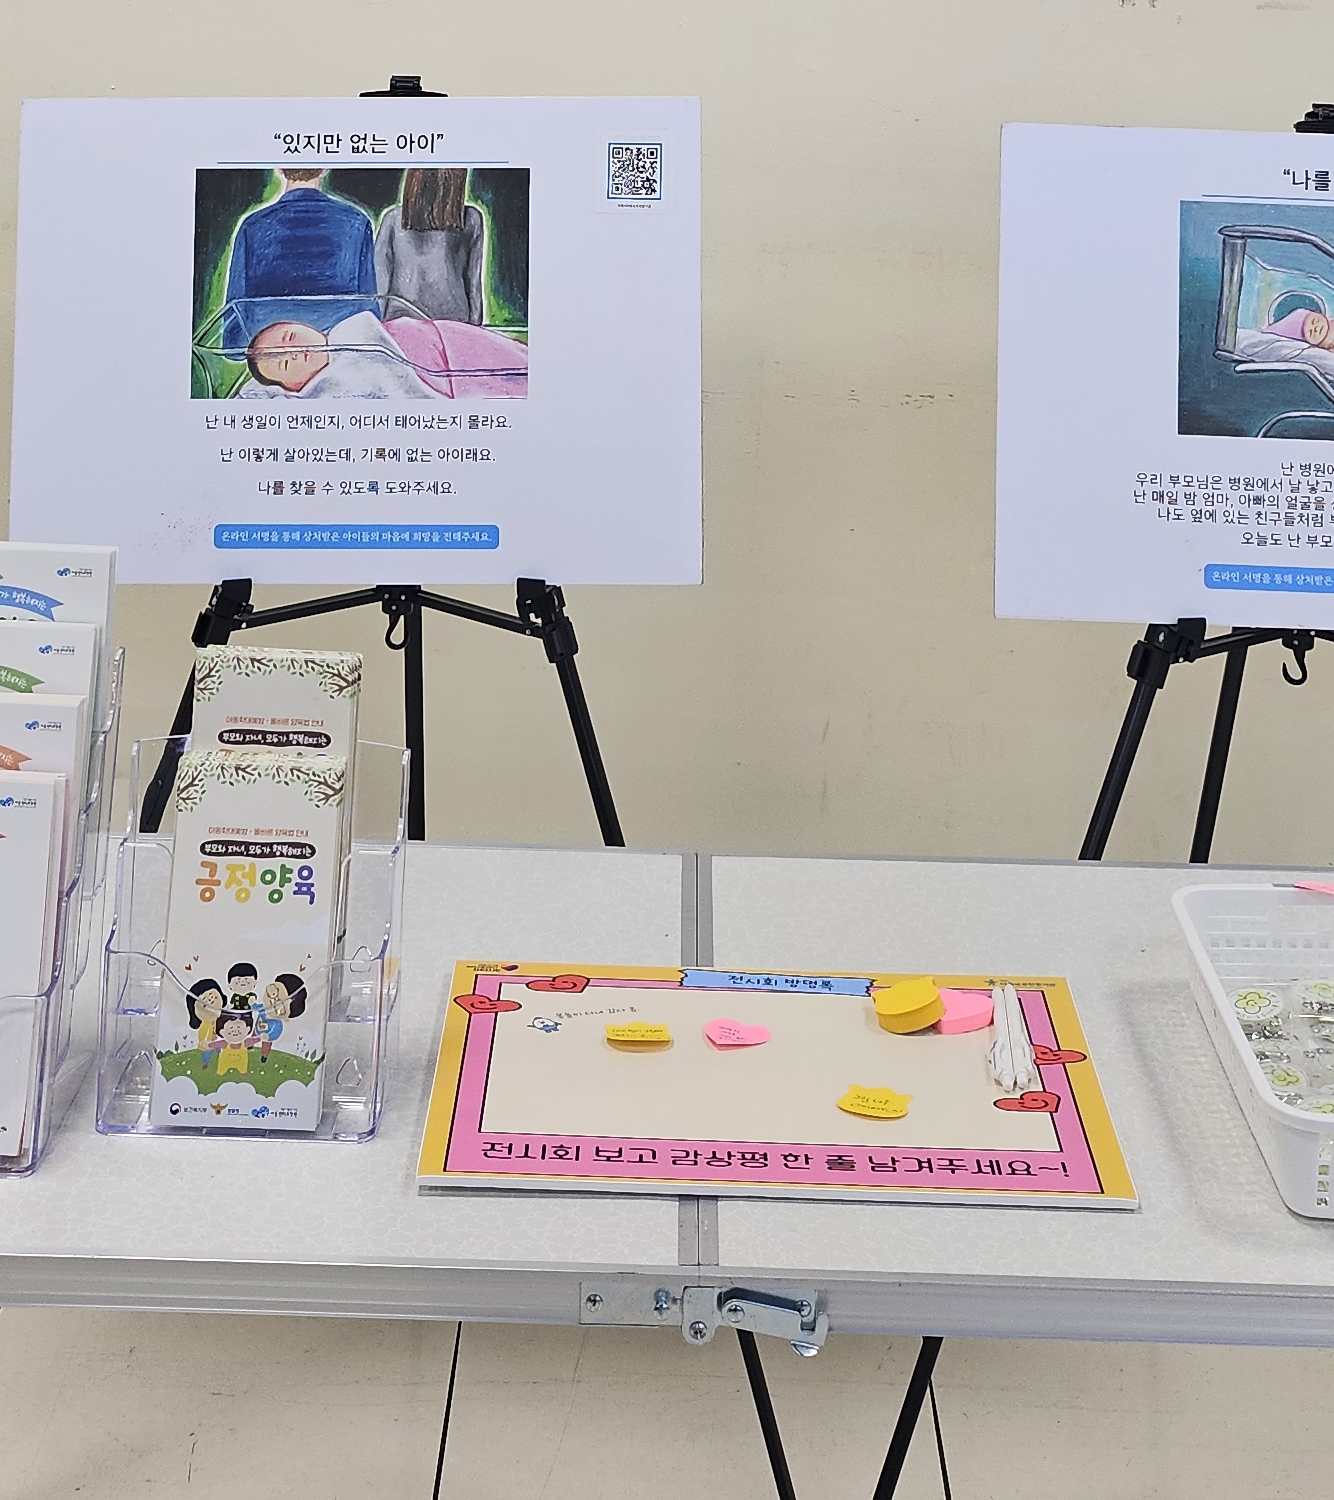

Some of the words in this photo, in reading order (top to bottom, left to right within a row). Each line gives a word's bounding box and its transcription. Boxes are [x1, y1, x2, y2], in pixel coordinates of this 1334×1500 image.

[273, 132, 343, 155] “있지만
[349, 132, 389, 154] 없는
[396, 132, 444, 154] 아이”
[1283, 168, 1332, 192] “나를
[205, 414, 220, 430] 난
[223, 414, 236, 430] 내
[240, 414, 281, 430] 생일이
[286, 414, 345, 431] 언제인지,
[349, 414, 390, 430] 어디서
[394, 414, 462, 430] 태어났는지
[467, 414, 512, 430] 몰라요.
[220, 447, 235, 463] 난
[238, 447, 279, 463] 이렇게
[283, 447, 356, 464] 살아있는데,
[360, 447, 401, 463] 기록에
[405, 447, 433, 463] 없는
[437, 447, 496, 463] 아이래요.
[1281, 461, 1295, 477] 난
[258, 480, 286, 496] 나를
[289, 480, 317, 496] 찾을
[321, 481, 335, 496] 수
[339, 480, 380, 496] 있도록
[384, 480, 457, 496] 도와주세요.
[1157, 506, 1186, 522] 나도
[1190, 508, 1217, 524] 옆에
[1222, 509, 1250, 526] 있는
[1254, 510, 1324, 528] 친구들처럼
[1240, 531, 1283, 547] 오늘도
[1287, 532, 1302, 549] 난
[195, 860, 315, 906] 긍정양육
[728, 974, 778, 987] 전시회
[481, 1141, 581, 1162] 전시회
[592, 1145, 659, 1164] 보고
[670, 1148, 769, 1169] 감상평
[780, 1152, 814, 1170] 한
[824, 1154, 857, 1172] 줄
